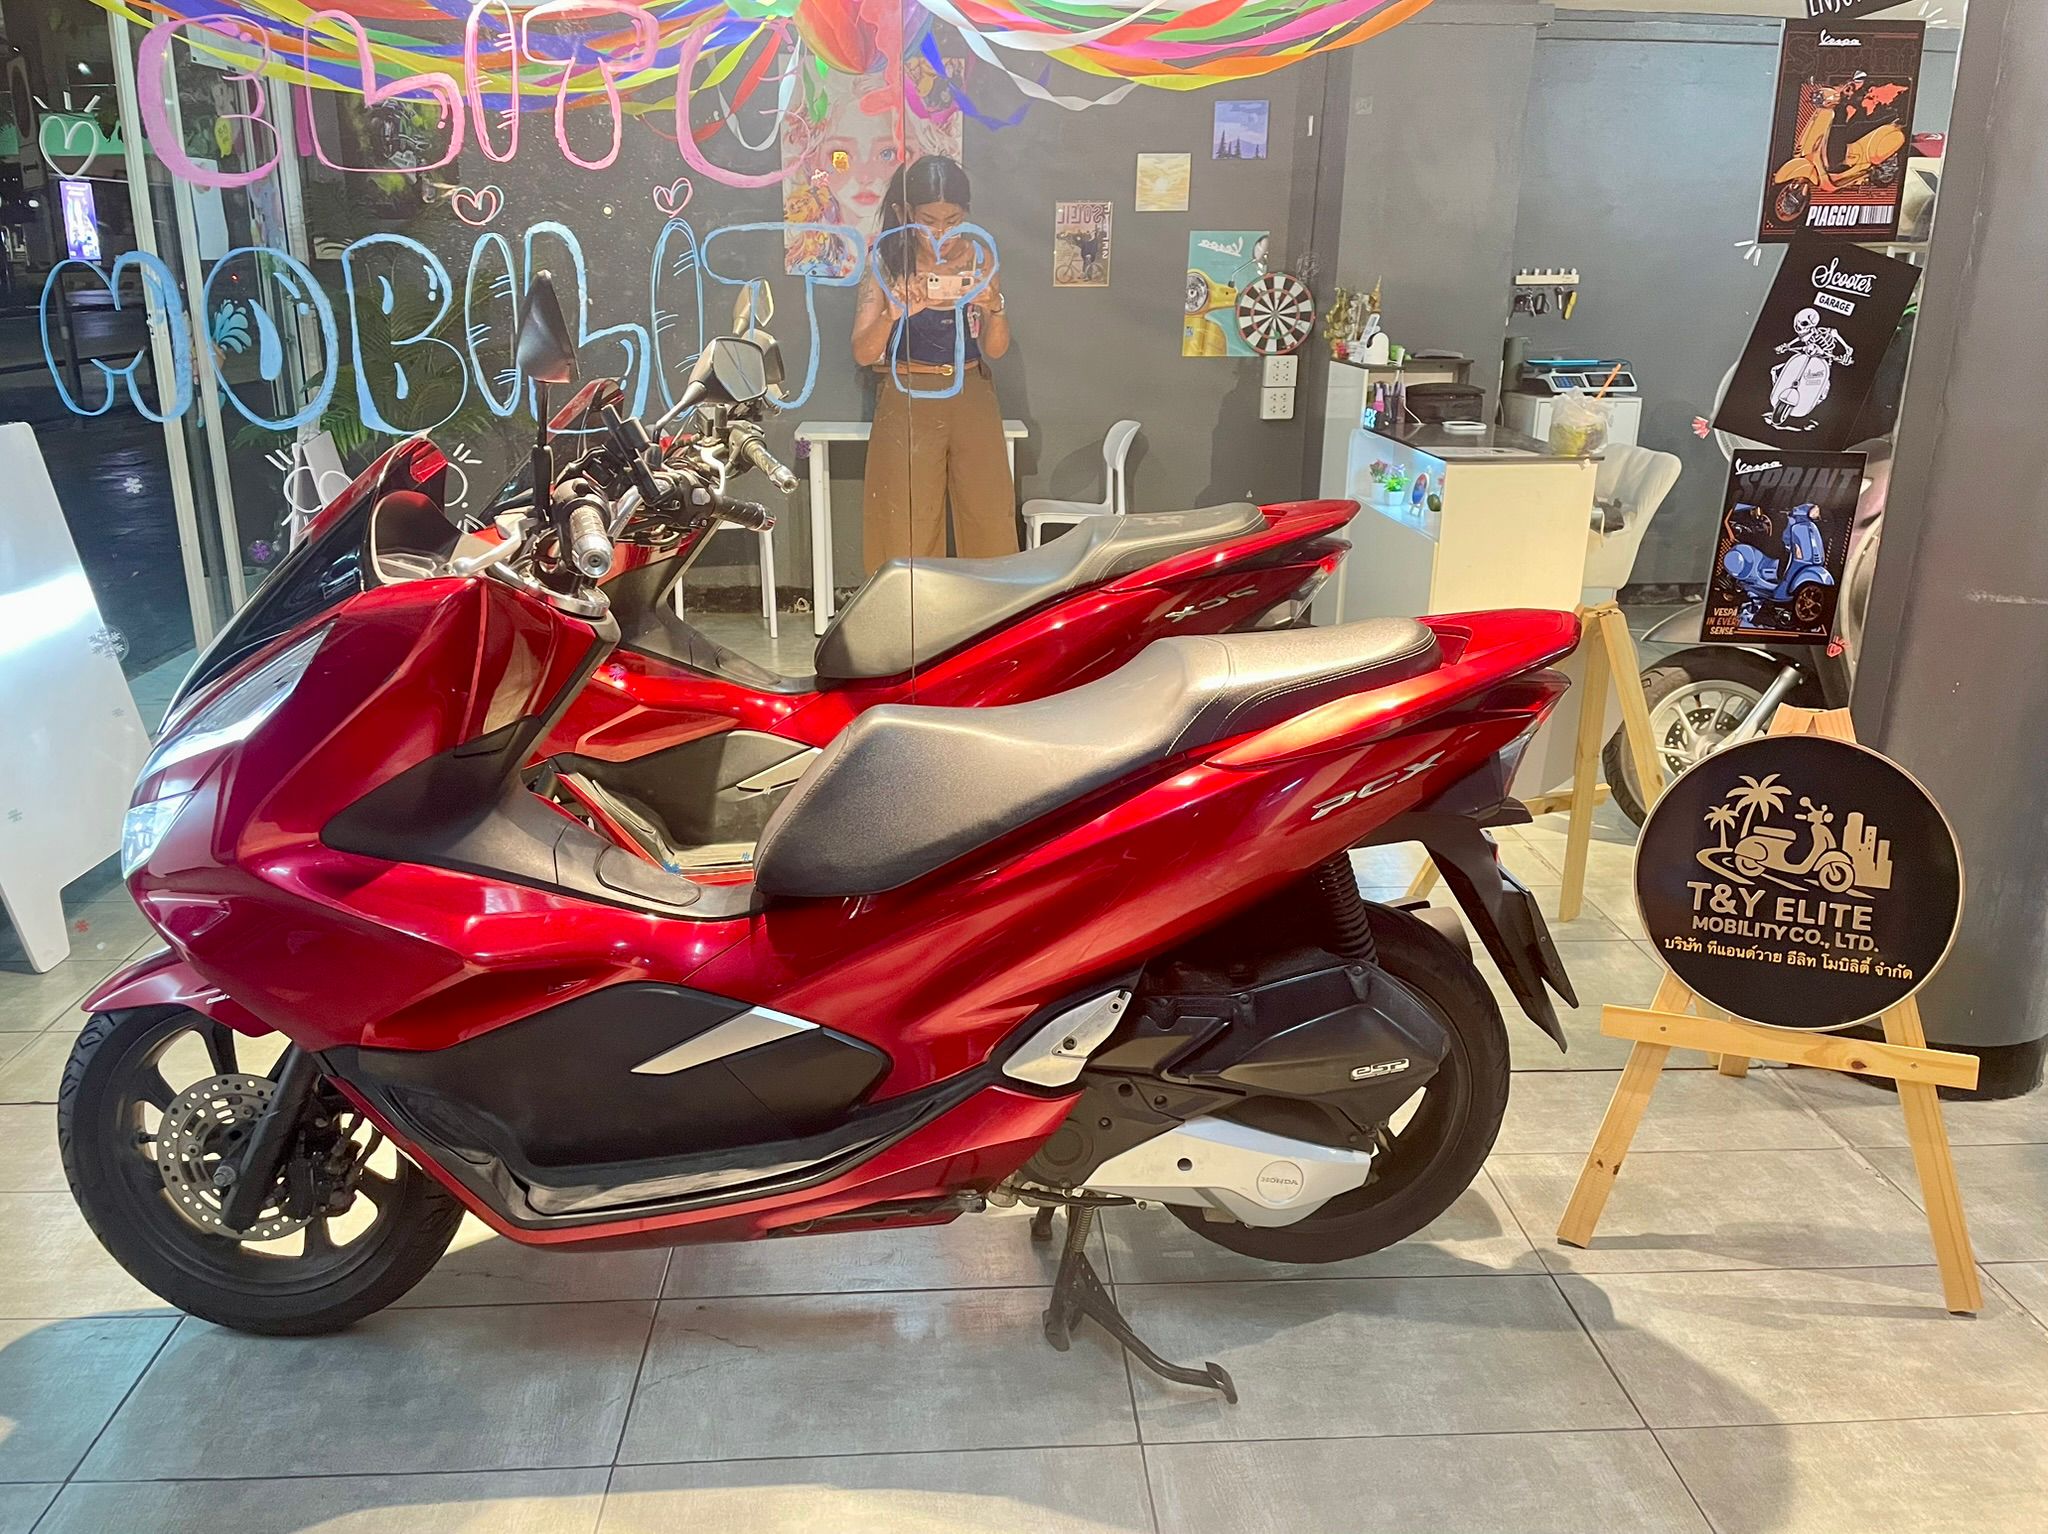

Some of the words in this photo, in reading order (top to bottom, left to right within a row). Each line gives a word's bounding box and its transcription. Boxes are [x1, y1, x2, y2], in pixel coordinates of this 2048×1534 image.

[1818, 28, 1862, 47] Vespa
[137, 0, 811, 188] ELITE
[1805, 204, 1861, 227] PIAGGIO
[1811, 256, 1877, 297] Scooter
[1818, 294, 1852, 313] GARAGE
[1735, 457, 1783, 476] Vespa
[1737, 465, 1863, 503] SPRINT
[1706, 616, 1716, 626] IN
[1713, 606, 1738, 617] VESPA
[1709, 626, 1736, 635] SENSE
[1310, 750, 1446, 821] PCX
[1686, 880, 1767, 919] T&Y
[1775, 896, 1874, 932] ELITE
[1834, 931, 1880, 953] LTD.
[1664, 935, 1703, 954] บริษัท
[1874, 960, 1914, 981] จำกัด
